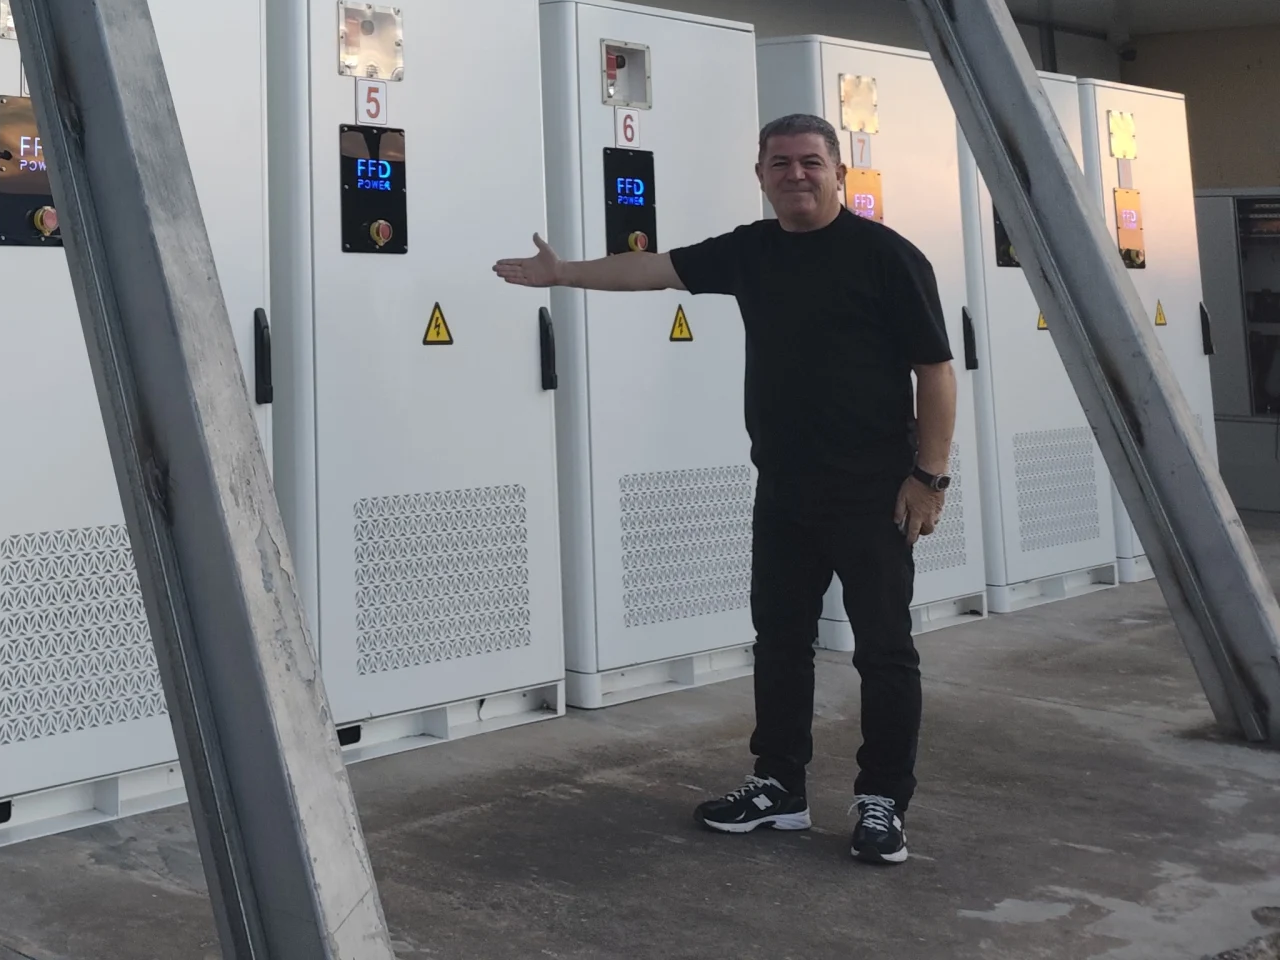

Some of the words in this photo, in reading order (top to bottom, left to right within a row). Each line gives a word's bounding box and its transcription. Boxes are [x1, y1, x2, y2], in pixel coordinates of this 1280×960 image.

[366, 86, 380, 119] 5
[623, 114, 635, 142] 6
[20, 136, 43, 157] FF
[857, 139, 865, 163] 7
[20, 160, 47, 171] POW
[357, 159, 391, 178] FFD
[357, 179, 391, 190] POWER
[617, 177, 644, 195] FFD
[854, 194, 875, 209] FFD
